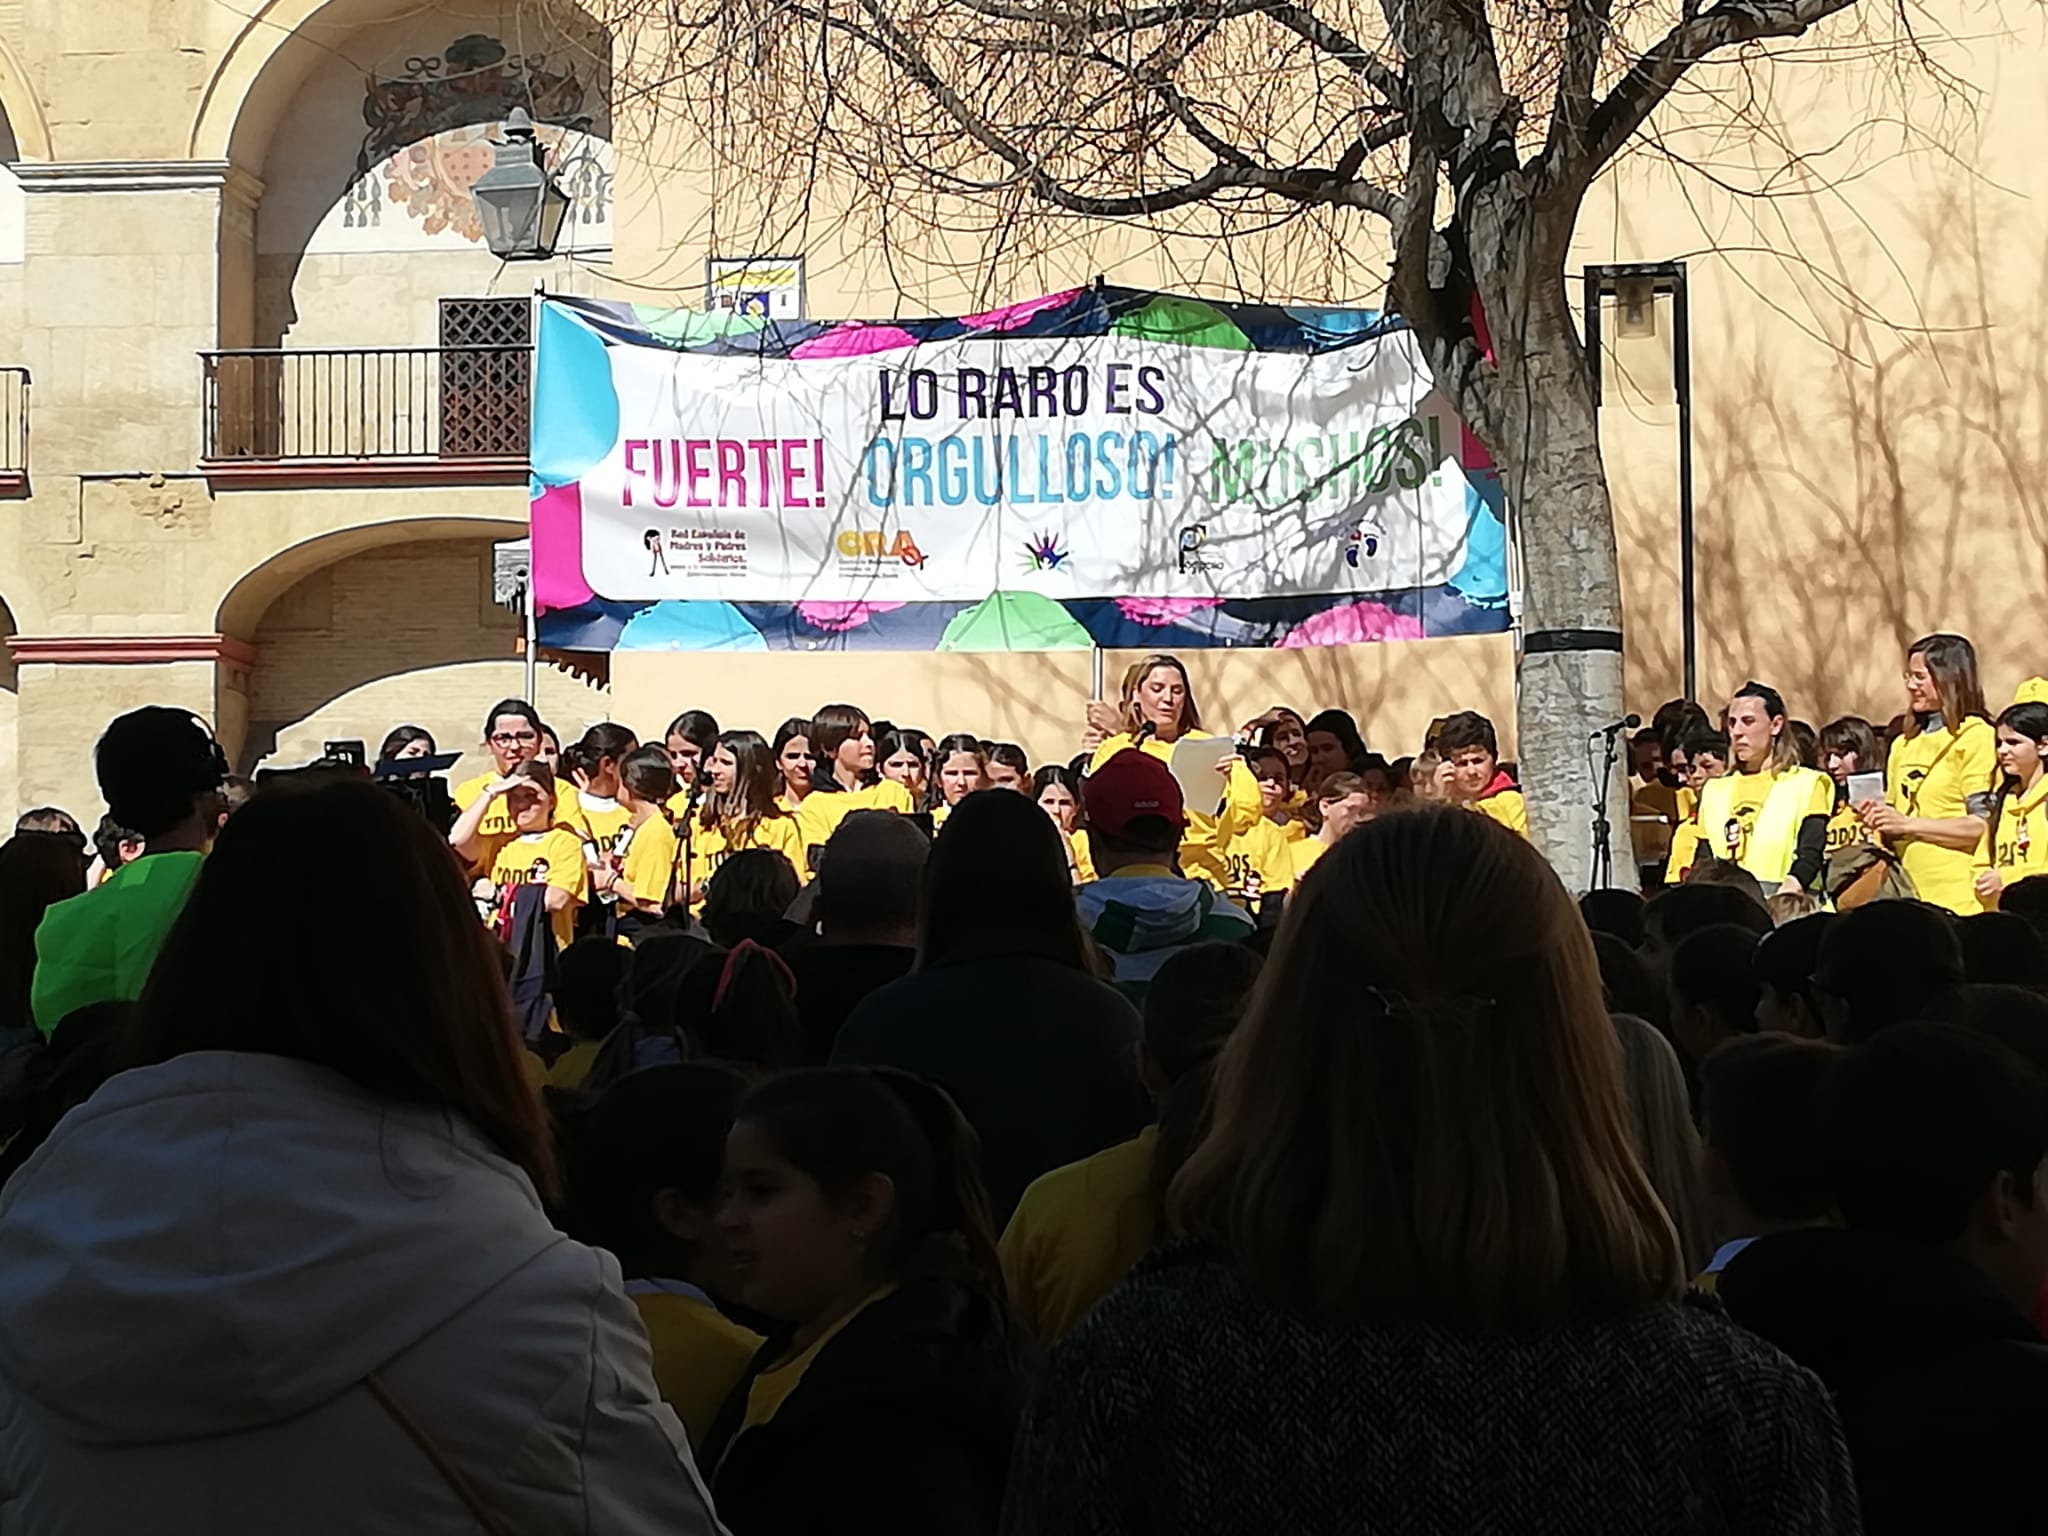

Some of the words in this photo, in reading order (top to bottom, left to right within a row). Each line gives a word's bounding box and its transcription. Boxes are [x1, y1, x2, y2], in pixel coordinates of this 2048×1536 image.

[880, 367, 938, 421] LO
[957, 365, 1088, 418] RARO
[1105, 362, 1165, 415] ES
[623, 439, 825, 508] FUERTE!
[866, 430, 1176, 507] ORGULLOSO!
[1209, 416, 1443, 505] MUCHOS!
